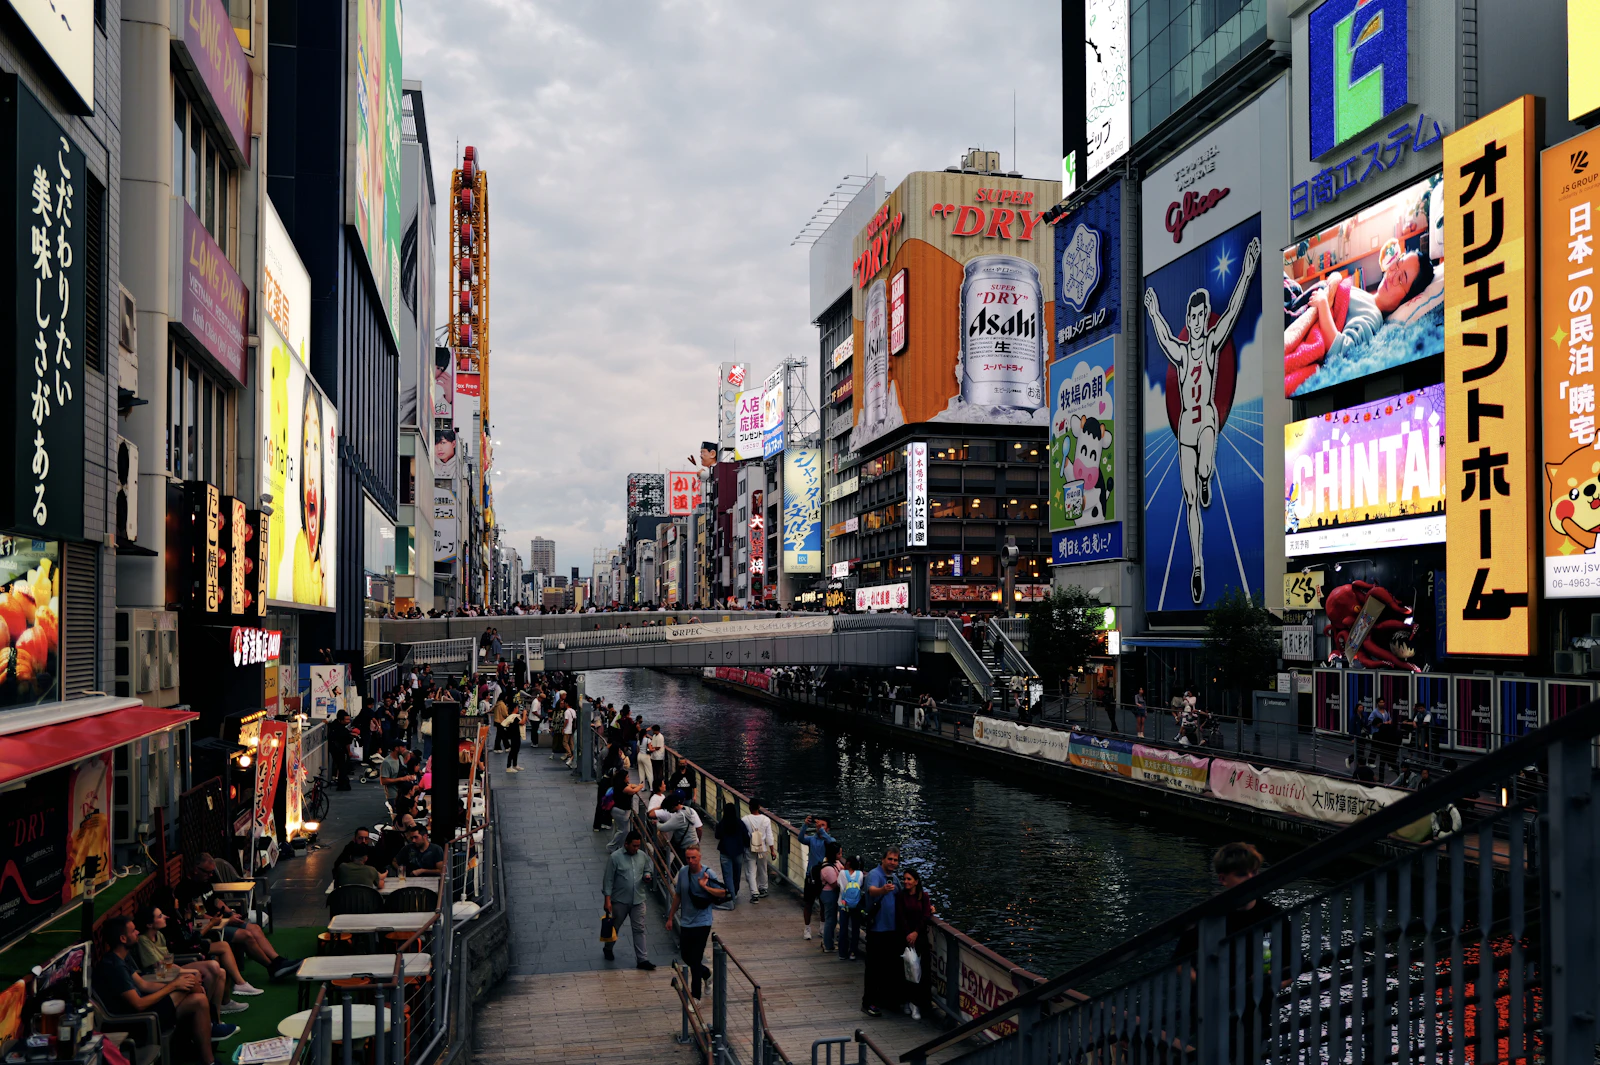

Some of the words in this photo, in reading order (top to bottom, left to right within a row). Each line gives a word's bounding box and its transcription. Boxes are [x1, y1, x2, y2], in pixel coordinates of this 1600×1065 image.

[1290, 113, 1442, 220] 日商エステム
[1561, 184, 1570, 195] JS
[1571, 173, 1599, 191] GROUP
[975, 186, 1034, 206] SUPER
[1166, 188, 1230, 244] Glico
[55, 136, 74, 406] こだわりたい
[189, 228, 219, 292] LONG
[221, 268, 246, 324] DINH
[990, 284, 1016, 292] SUPER
[189, 271, 214, 311] VIETNAM
[215, 303, 245, 347] RESTAURANT
[969, 306, 1036, 340] Asahi
[1058, 308, 1105, 344] 雪印メグミルク
[31, 164, 52, 526] 美味しさがある
[983, 363, 1024, 373] スーパードライ
[994, 341, 1012, 354] 生
[1061, 374, 1103, 411] 牧場の朝
[1190, 360, 1203, 425] グリコ
[1459, 139, 1528, 621] オリエントホーム
[740, 396, 760, 415] 入店
[259, 516, 267, 615] 串かつ
